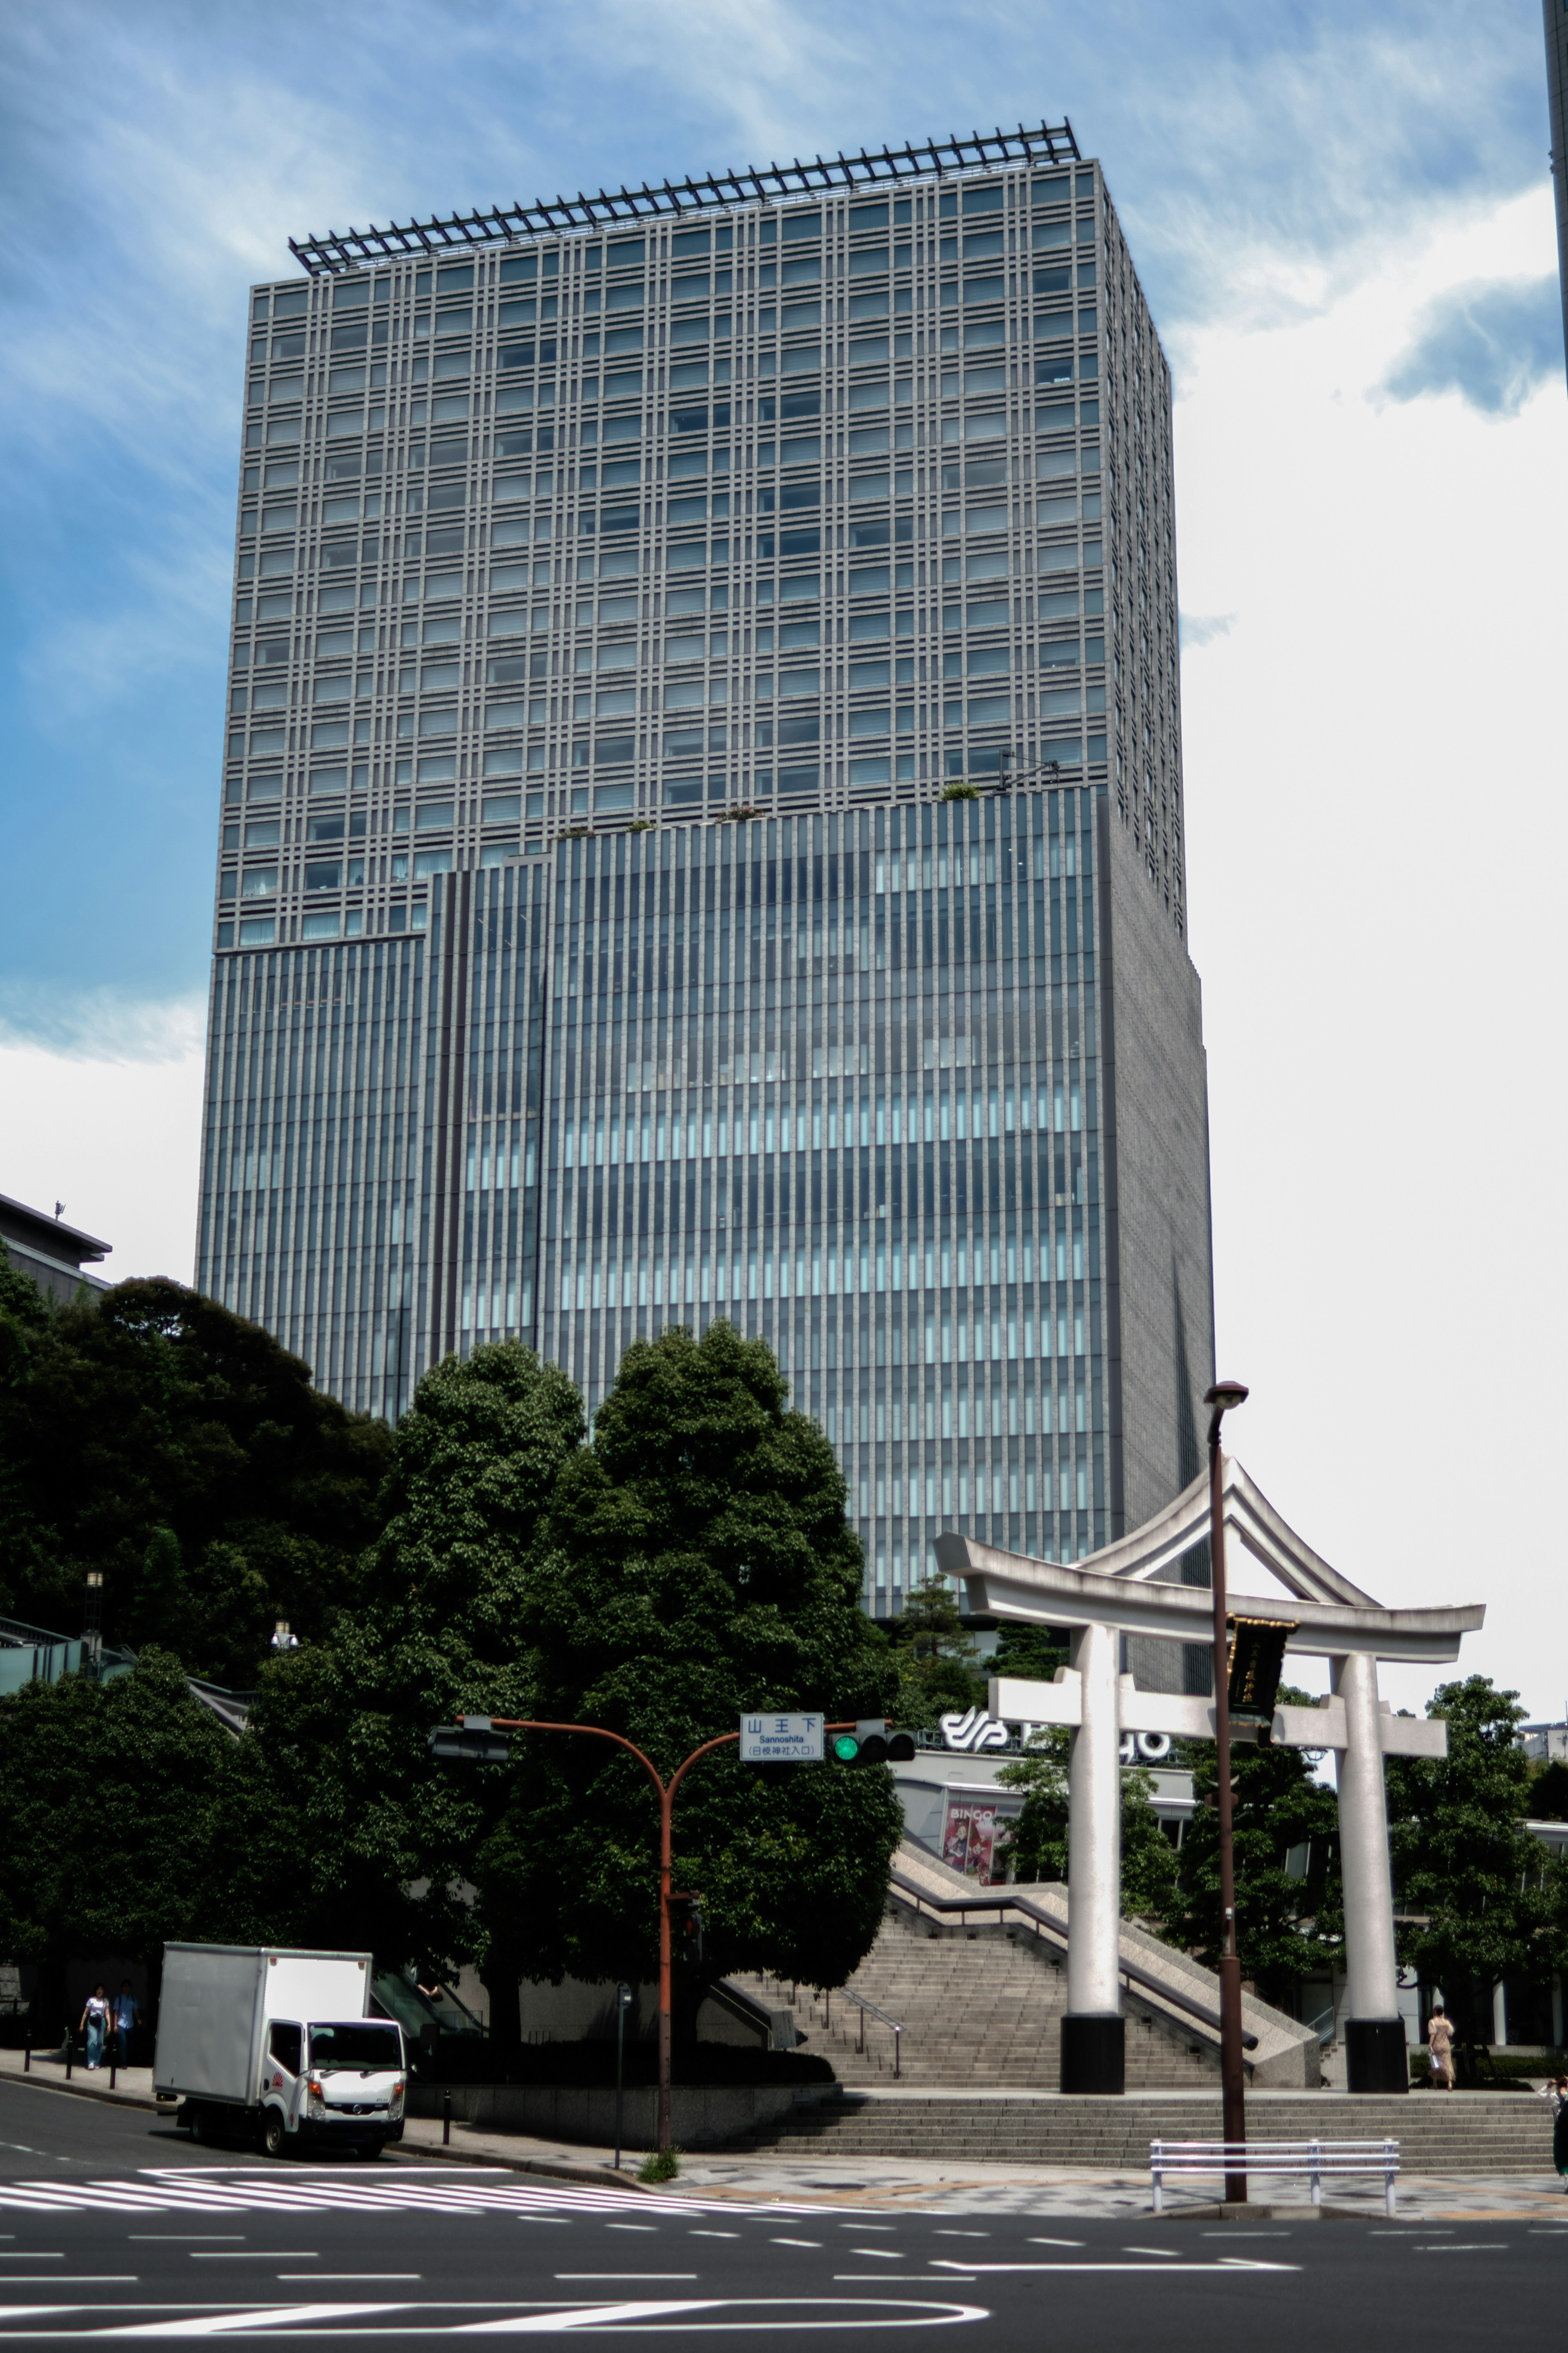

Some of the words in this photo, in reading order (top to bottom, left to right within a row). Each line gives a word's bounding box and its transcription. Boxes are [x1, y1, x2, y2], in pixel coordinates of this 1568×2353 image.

[748, 1717, 816, 1733] 山王下
[749, 1745, 814, 1756] (日枝神社入口)
[950, 1808, 993, 1820] BINGO
